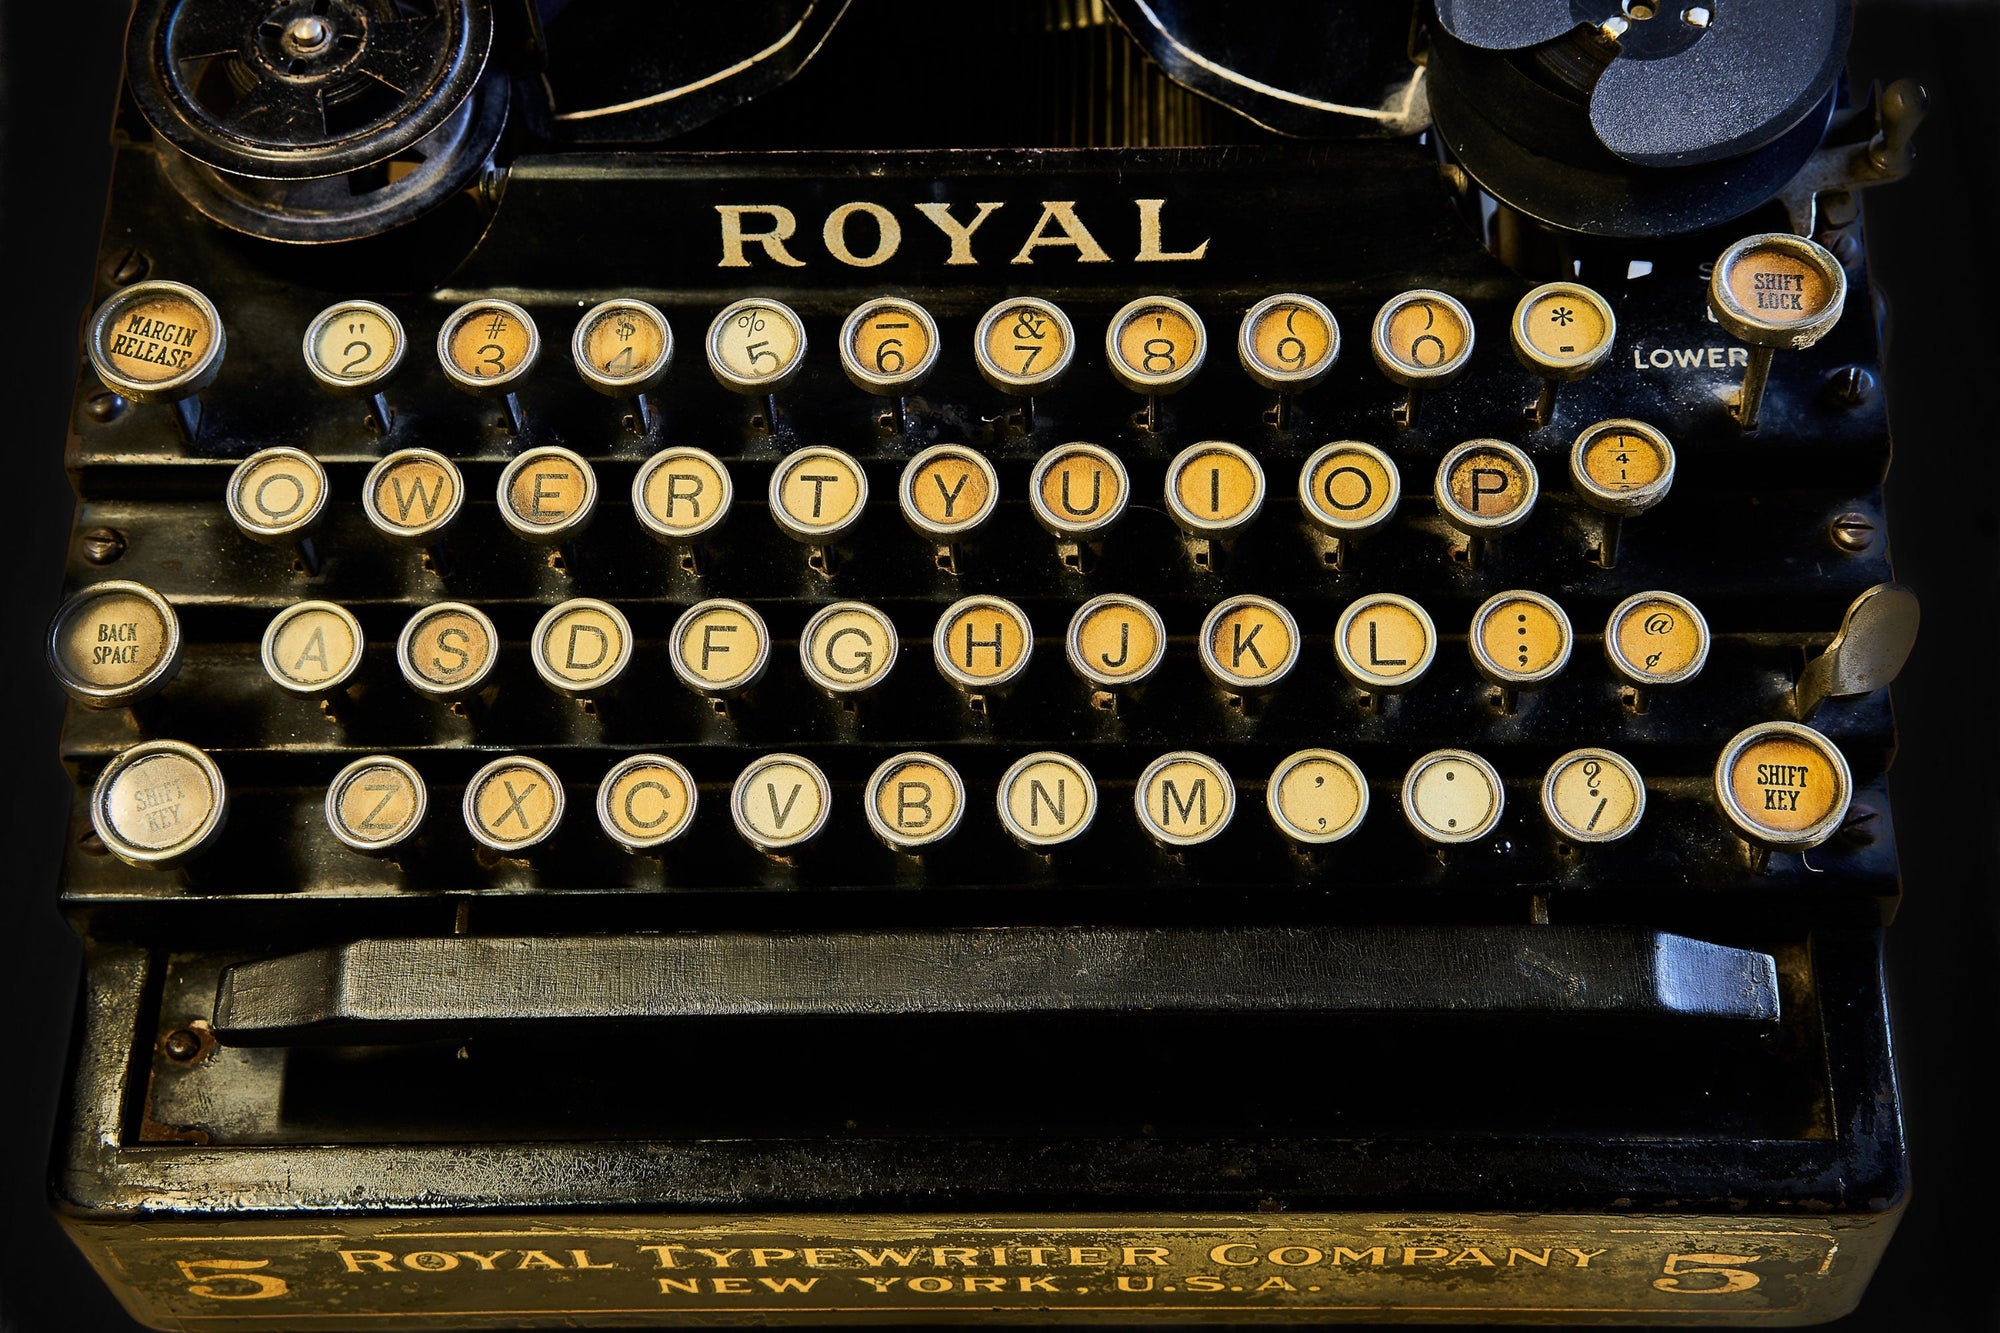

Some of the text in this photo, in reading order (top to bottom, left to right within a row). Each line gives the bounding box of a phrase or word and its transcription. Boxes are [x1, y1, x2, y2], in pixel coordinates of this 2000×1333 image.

[714, 199, 1210, 267] ROYAL
[1753, 272, 1804, 292] SHIFT
[1757, 292, 1803, 311] LOCK
[126, 314, 198, 348] MARGIN
[485, 313, 506, 341] #
[737, 311, 766, 338] %
[1012, 311, 1046, 340] &
[110, 333, 193, 369] RELEASE
[341, 340, 373, 375] 2
[475, 344, 506, 376] 3
[745, 340, 782, 376] 5
[875, 338, 905, 375] 6
[1014, 344, 1043, 376] 7
[1142, 338, 1176, 375] 8
[1276, 336, 1306, 370] 9
[1634, 347, 1749, 370] LOWER
[255, 474, 304, 520] Q
[391, 475, 444, 522] W
[532, 473, 569, 517] E
[665, 473, 704, 518] R
[800, 475, 839, 518] T
[933, 473, 969, 518] Y
[1061, 470, 1101, 516] U
[1210, 468, 1219, 512] I
[1323, 466, 1372, 511] O
[1470, 468, 1509, 512] P
[98, 623, 139, 643] BACK
[965, 622, 1002, 668] H
[1101, 622, 1129, 668] J
[1369, 621, 1407, 666] L
[1644, 613, 1674, 635] @
[92, 645, 139, 665] SPACE
[294, 626, 329, 672] A
[433, 628, 470, 674] S
[565, 624, 609, 670] D
[701, 625, 738, 670] F
[825, 627, 873, 675] G
[1232, 623, 1268, 669] K
[134, 778, 186, 813] SHIFT
[1583, 761, 1602, 797] ?
[1757, 764, 1808, 788] SHIFT
[148, 804, 181, 833] KEY
[358, 783, 400, 830] Z
[491, 780, 537, 829] X
[624, 781, 671, 829] C
[767, 783, 802, 830] V
[897, 782, 933, 828] B
[1030, 779, 1066, 827] N
[1162, 778, 1207, 827] M
[1764, 789, 1800, 811] KEY
[176, 1258, 290, 1300] 5
[338, 1243, 1608, 1274] ROYAL TYPEWRITER COMPANY
[1652, 1252, 1761, 1294] 5
[658, 1274, 1322, 1296] NEW YORK, U.S.A.
